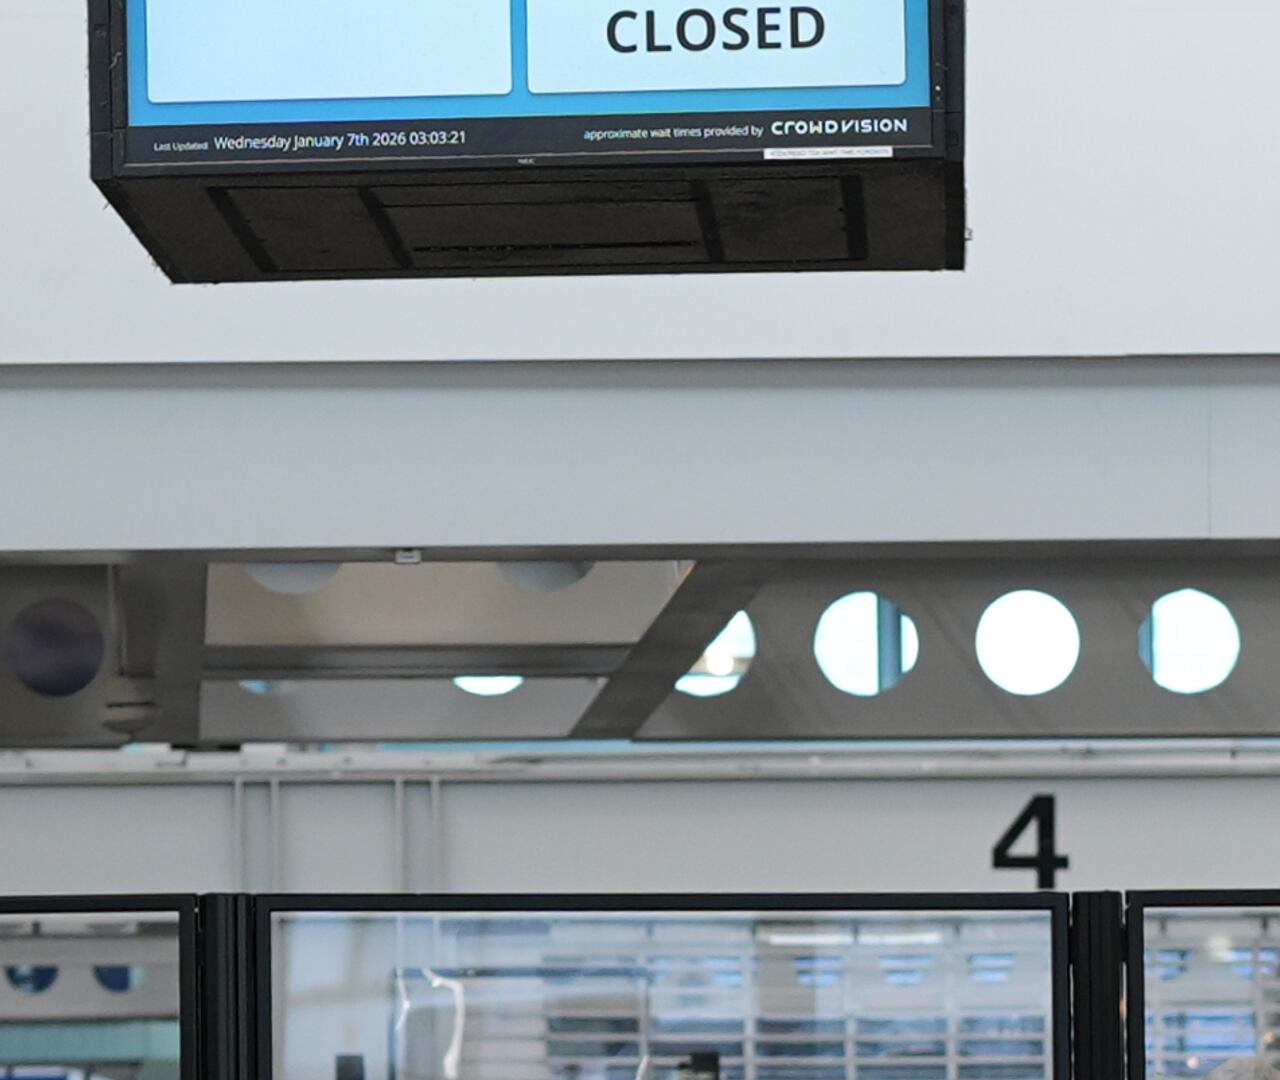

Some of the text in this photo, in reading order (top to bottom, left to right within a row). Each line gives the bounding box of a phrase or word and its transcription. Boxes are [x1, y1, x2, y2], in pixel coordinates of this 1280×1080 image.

[606, 6, 825, 53] CLOSED
[214, 130, 465, 151] Wednesday January 7th 2026 03:03:21
[583, 124, 765, 141] approximate wait times provided by
[153, 142, 171, 152] Last
[991, 794, 1070, 890] 4
